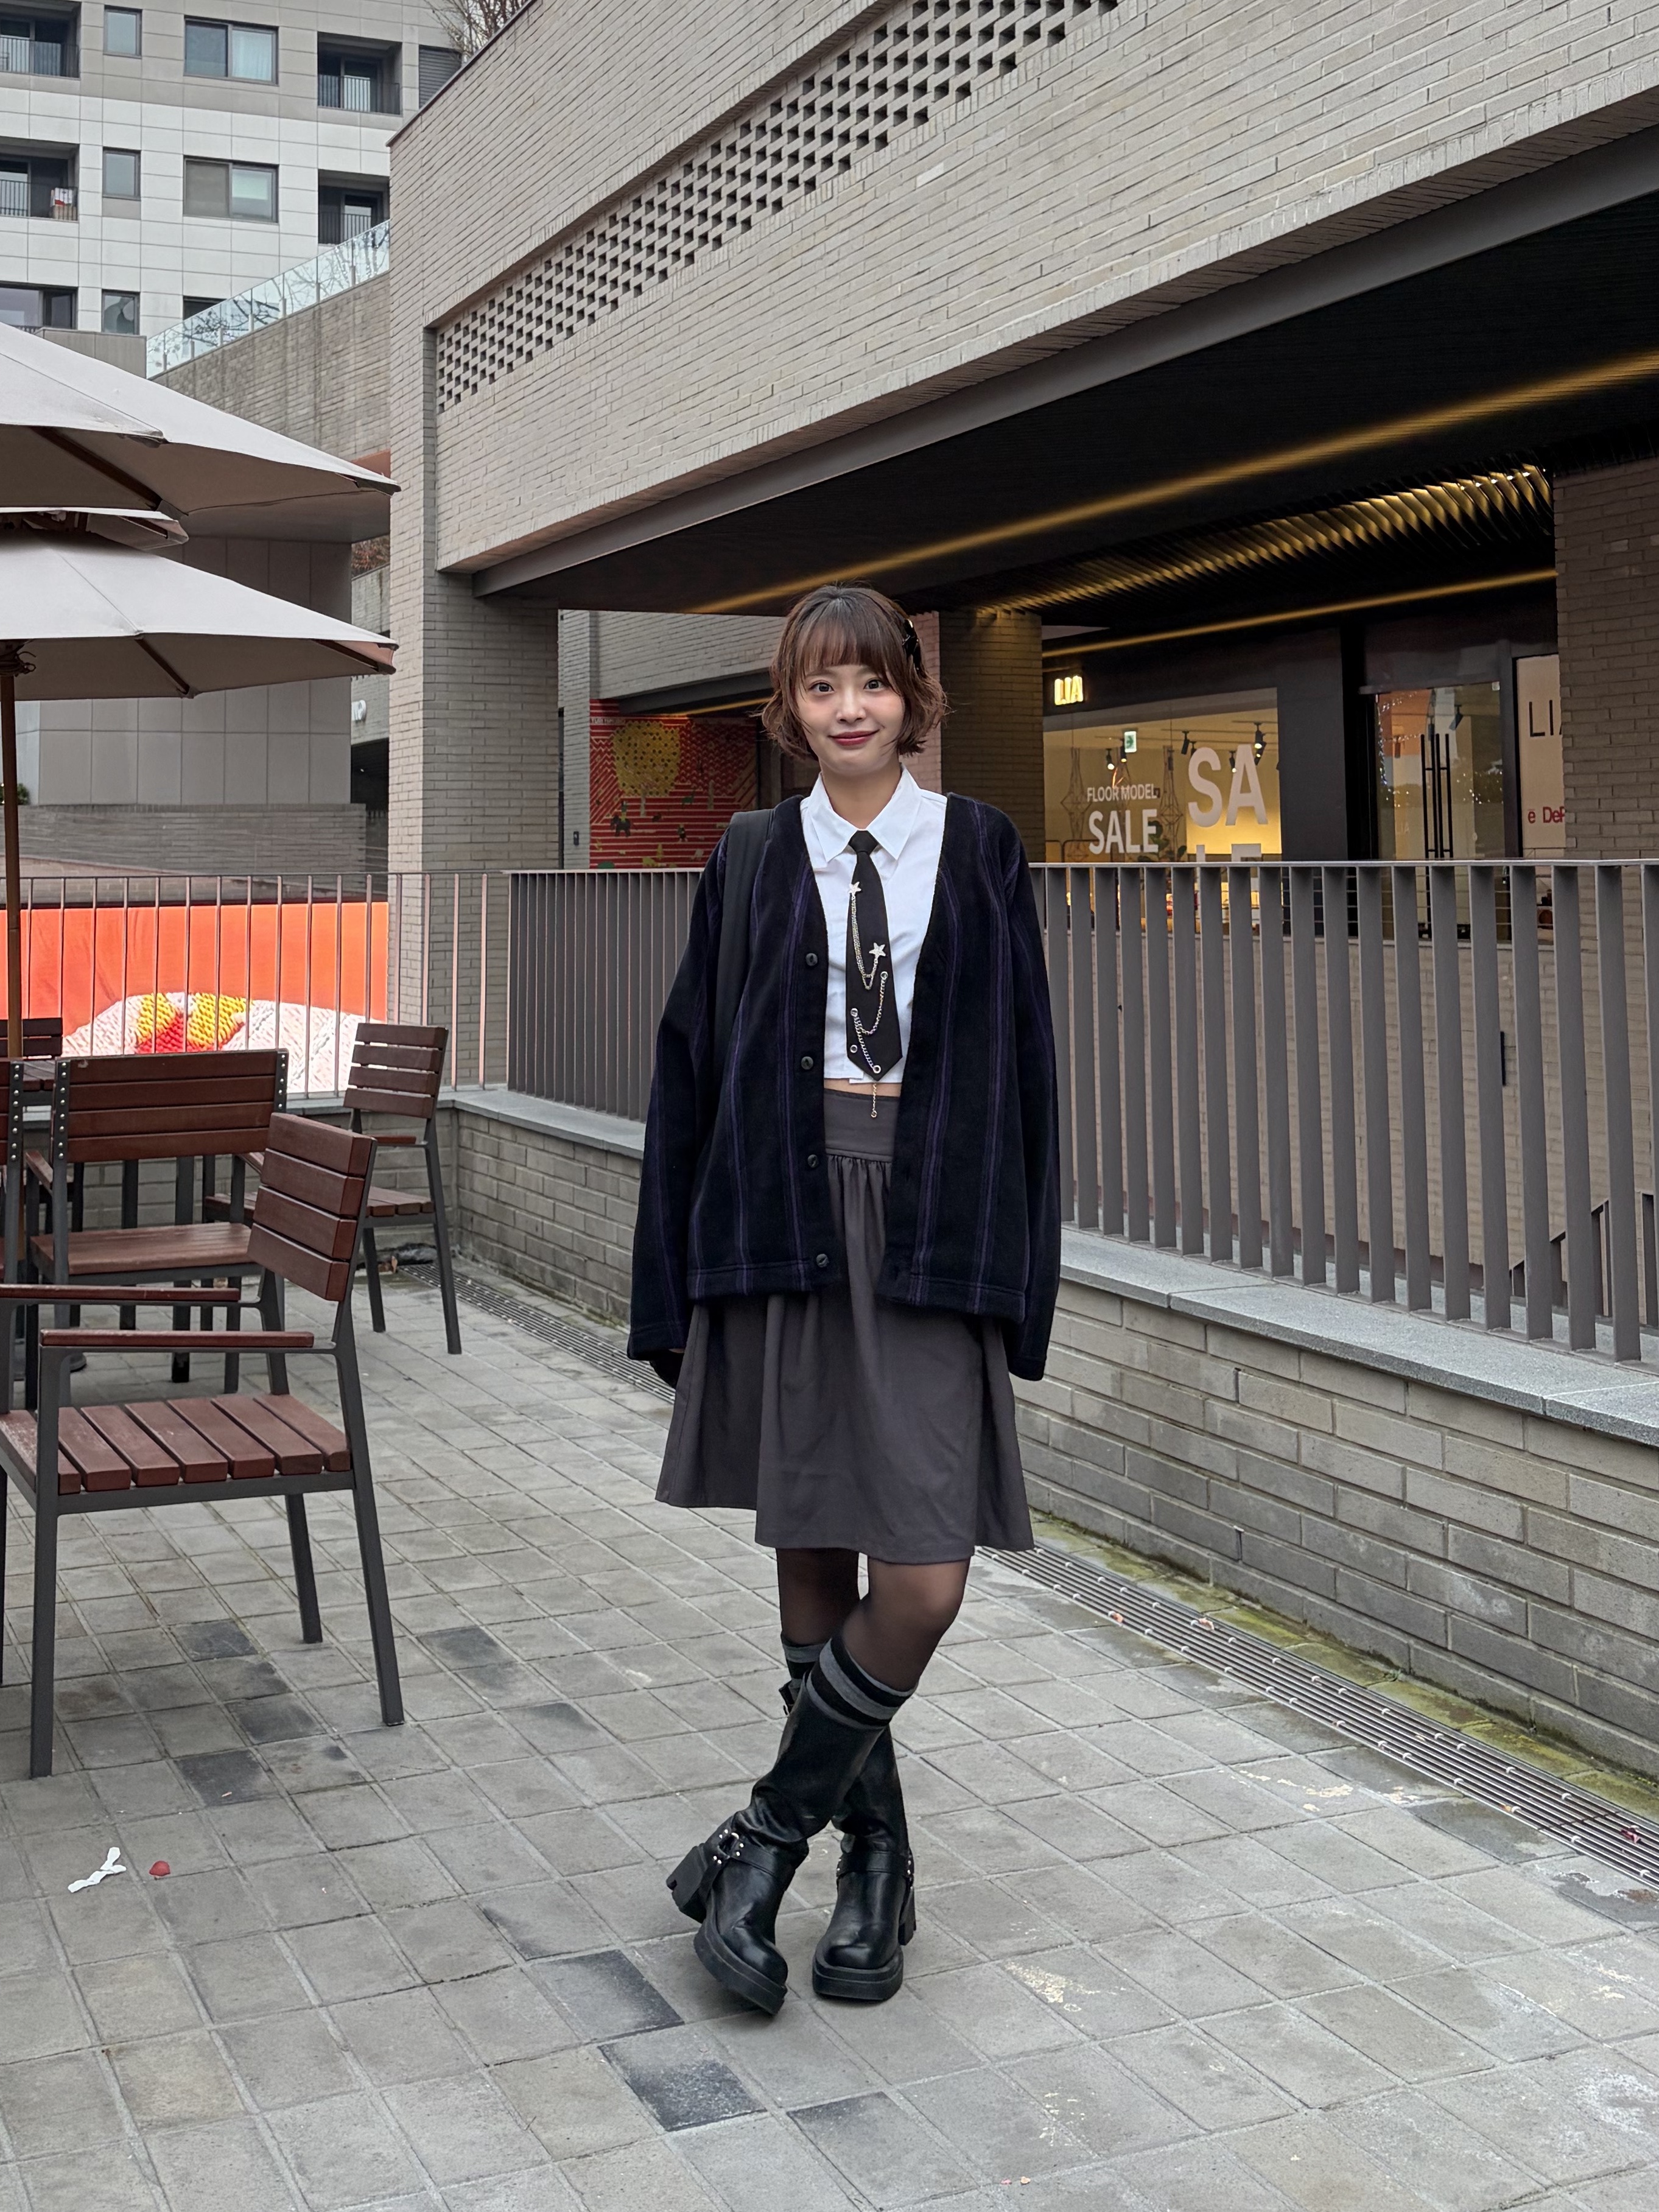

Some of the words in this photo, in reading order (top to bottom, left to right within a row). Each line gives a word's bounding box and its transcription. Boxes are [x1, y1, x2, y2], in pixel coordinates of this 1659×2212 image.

[1054, 675, 1084, 706] LIA
[1529, 700, 1562, 737] LI
[1087, 786, 1120, 802] FLOOR
[1121, 783, 1157, 801] MODEL
[1188, 744, 1268, 827] SA
[1089, 809, 1159, 854] SALE
